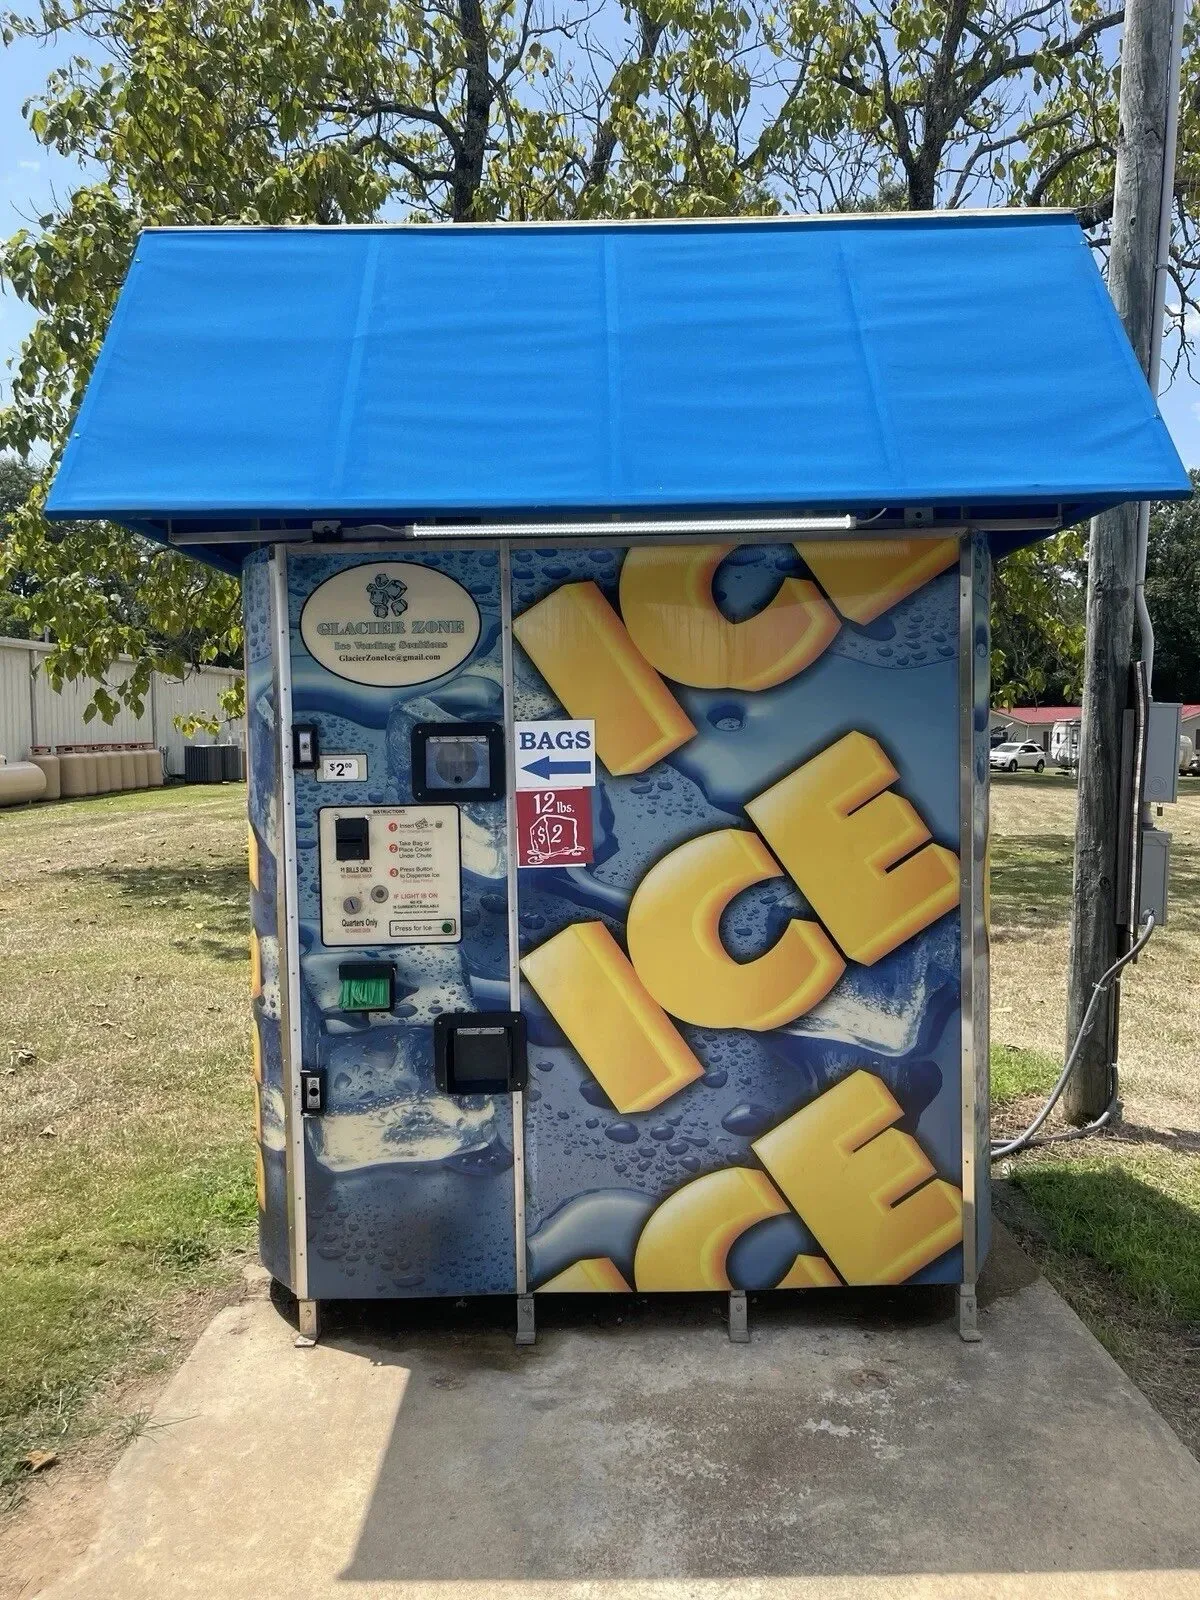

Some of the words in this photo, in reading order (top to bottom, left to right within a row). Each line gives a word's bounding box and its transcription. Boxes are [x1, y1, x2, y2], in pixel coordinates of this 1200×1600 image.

[317, 621, 406, 636] GLACIER
[411, 620, 465, 634] ZONE
[354, 641, 396, 651] Vending
[338, 654, 441, 662] GlacierZoneIce@gmail.com
[519, 731, 591, 750] BAGS
[533, 792, 555, 814] 12
[556, 802, 575, 813] lbs.
[345, 866, 360, 874] BILLS
[342, 919, 365, 927] Quarters
[365, 918, 378, 928] Only
[519, 730, 961, 1114] ICE
